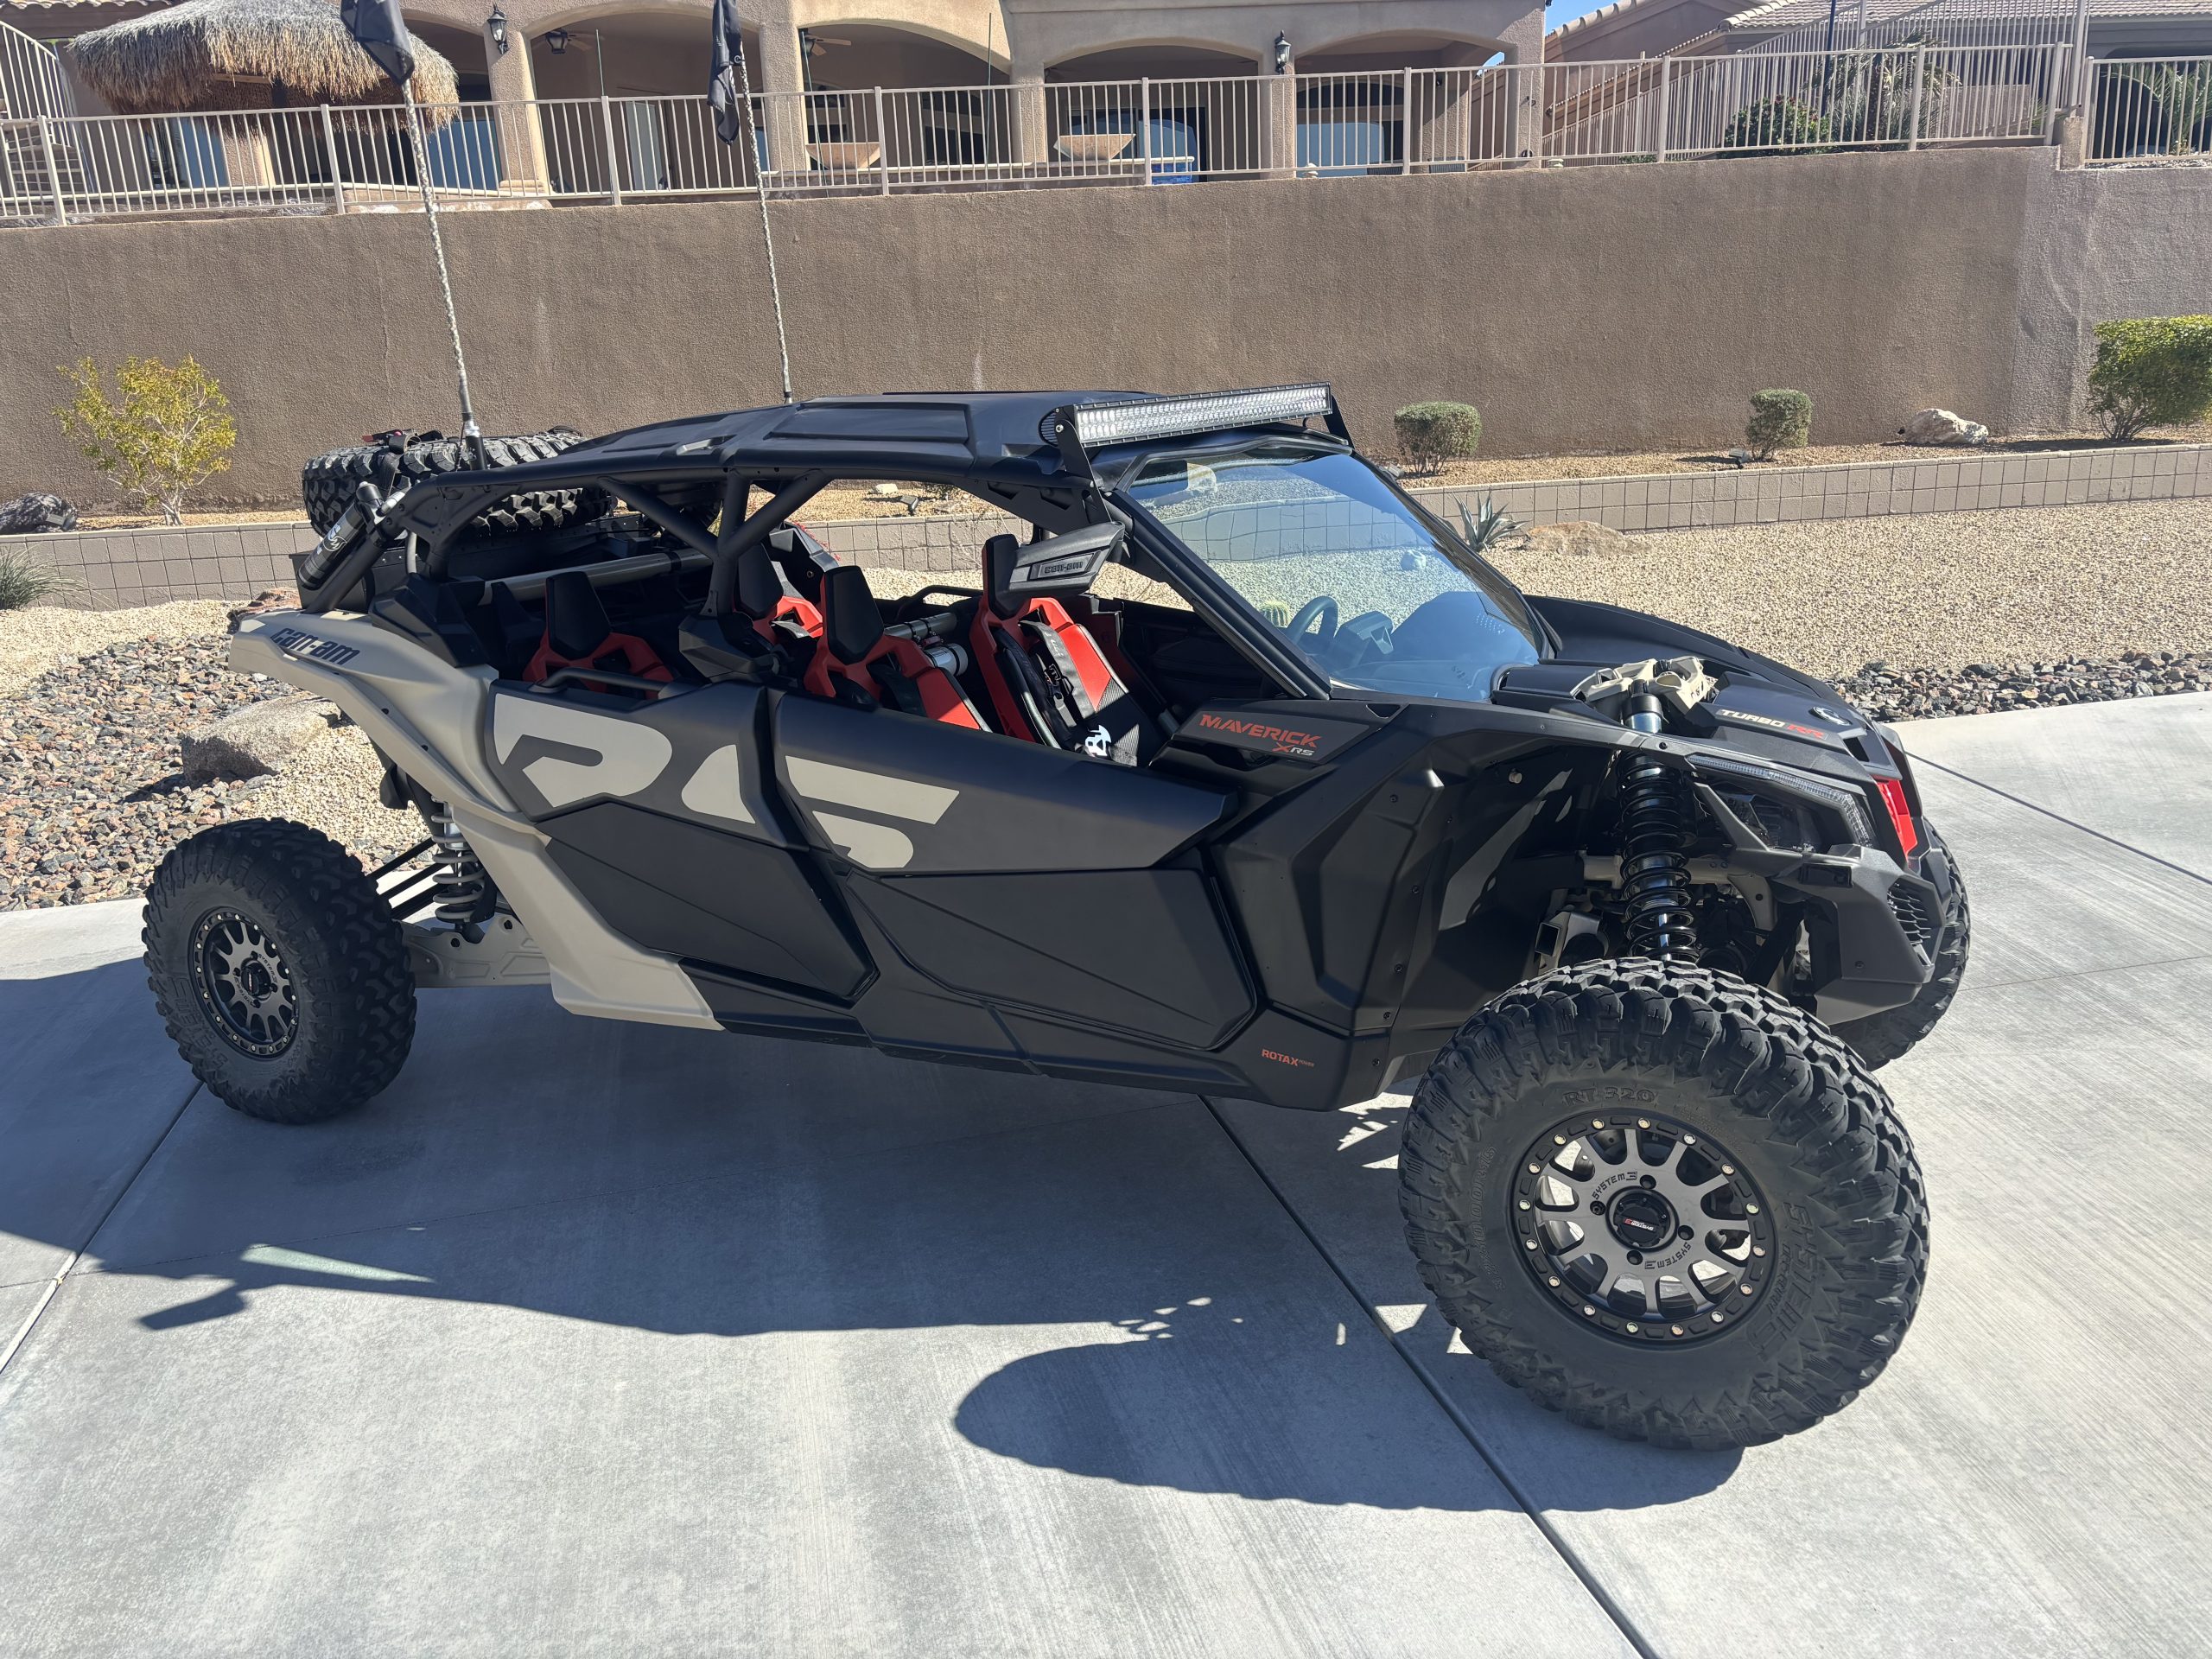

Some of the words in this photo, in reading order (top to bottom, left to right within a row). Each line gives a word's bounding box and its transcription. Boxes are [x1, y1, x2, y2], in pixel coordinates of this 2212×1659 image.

[270, 628, 360, 665] can-am
[1200, 715, 1321, 747] MAVERICK
[1721, 709, 1785, 728] TURBO
[1787, 724, 1824, 739] RR
[1262, 1049, 1299, 1066] ROTAX
[1605, 1086, 1657, 1104] 320
